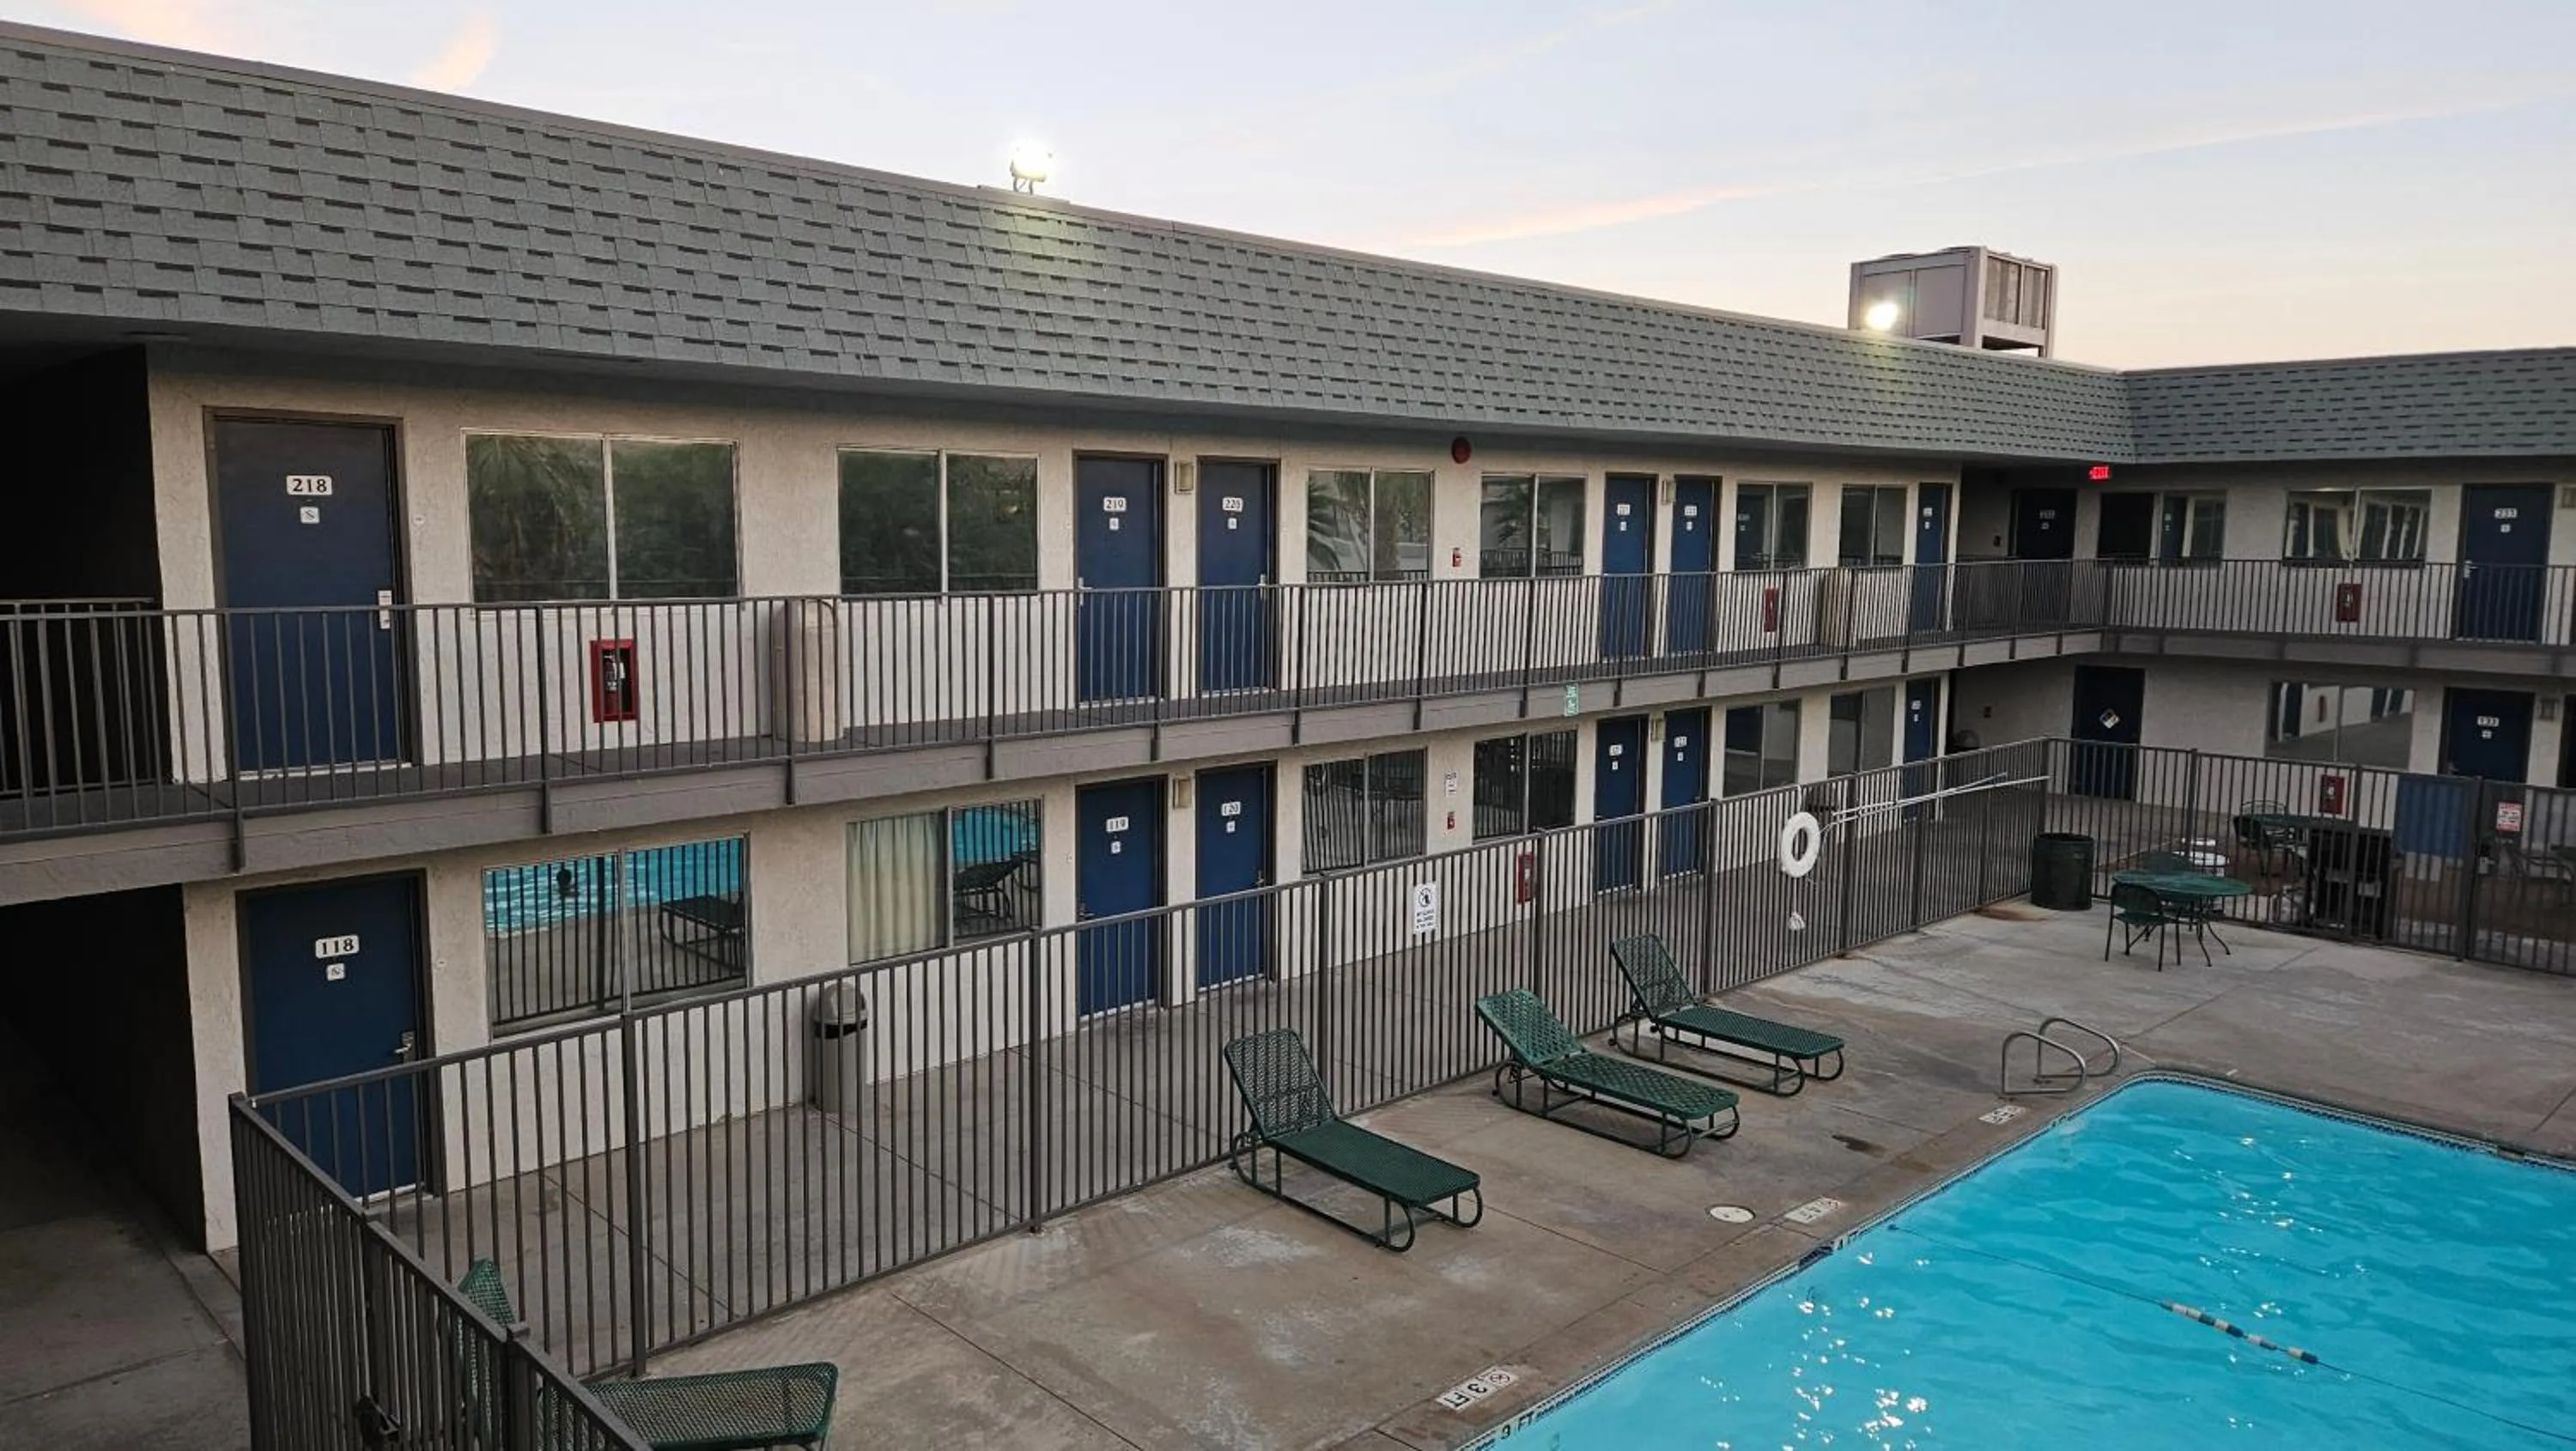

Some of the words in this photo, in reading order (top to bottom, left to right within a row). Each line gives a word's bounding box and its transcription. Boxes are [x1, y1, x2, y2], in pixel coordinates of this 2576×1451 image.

[293, 478, 327, 493] 218
[1105, 499, 1124, 509] 219
[322, 938, 354, 955] 118
